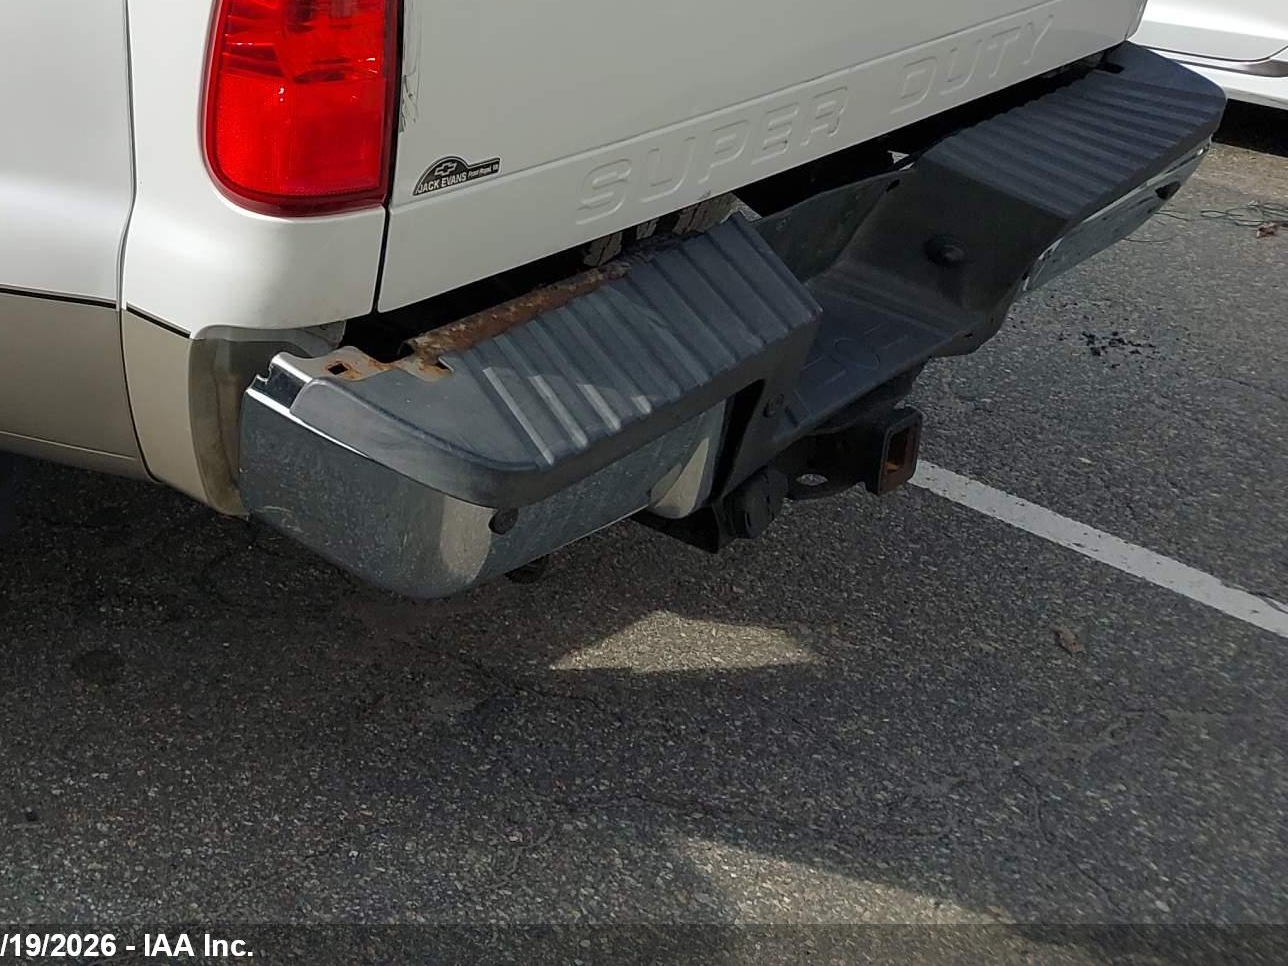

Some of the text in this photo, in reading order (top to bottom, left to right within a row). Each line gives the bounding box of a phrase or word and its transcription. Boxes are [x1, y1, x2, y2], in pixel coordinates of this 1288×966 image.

[574, 14, 1055, 225] SUPER DUTY
[418, 172, 467, 193] JACK EVANS
